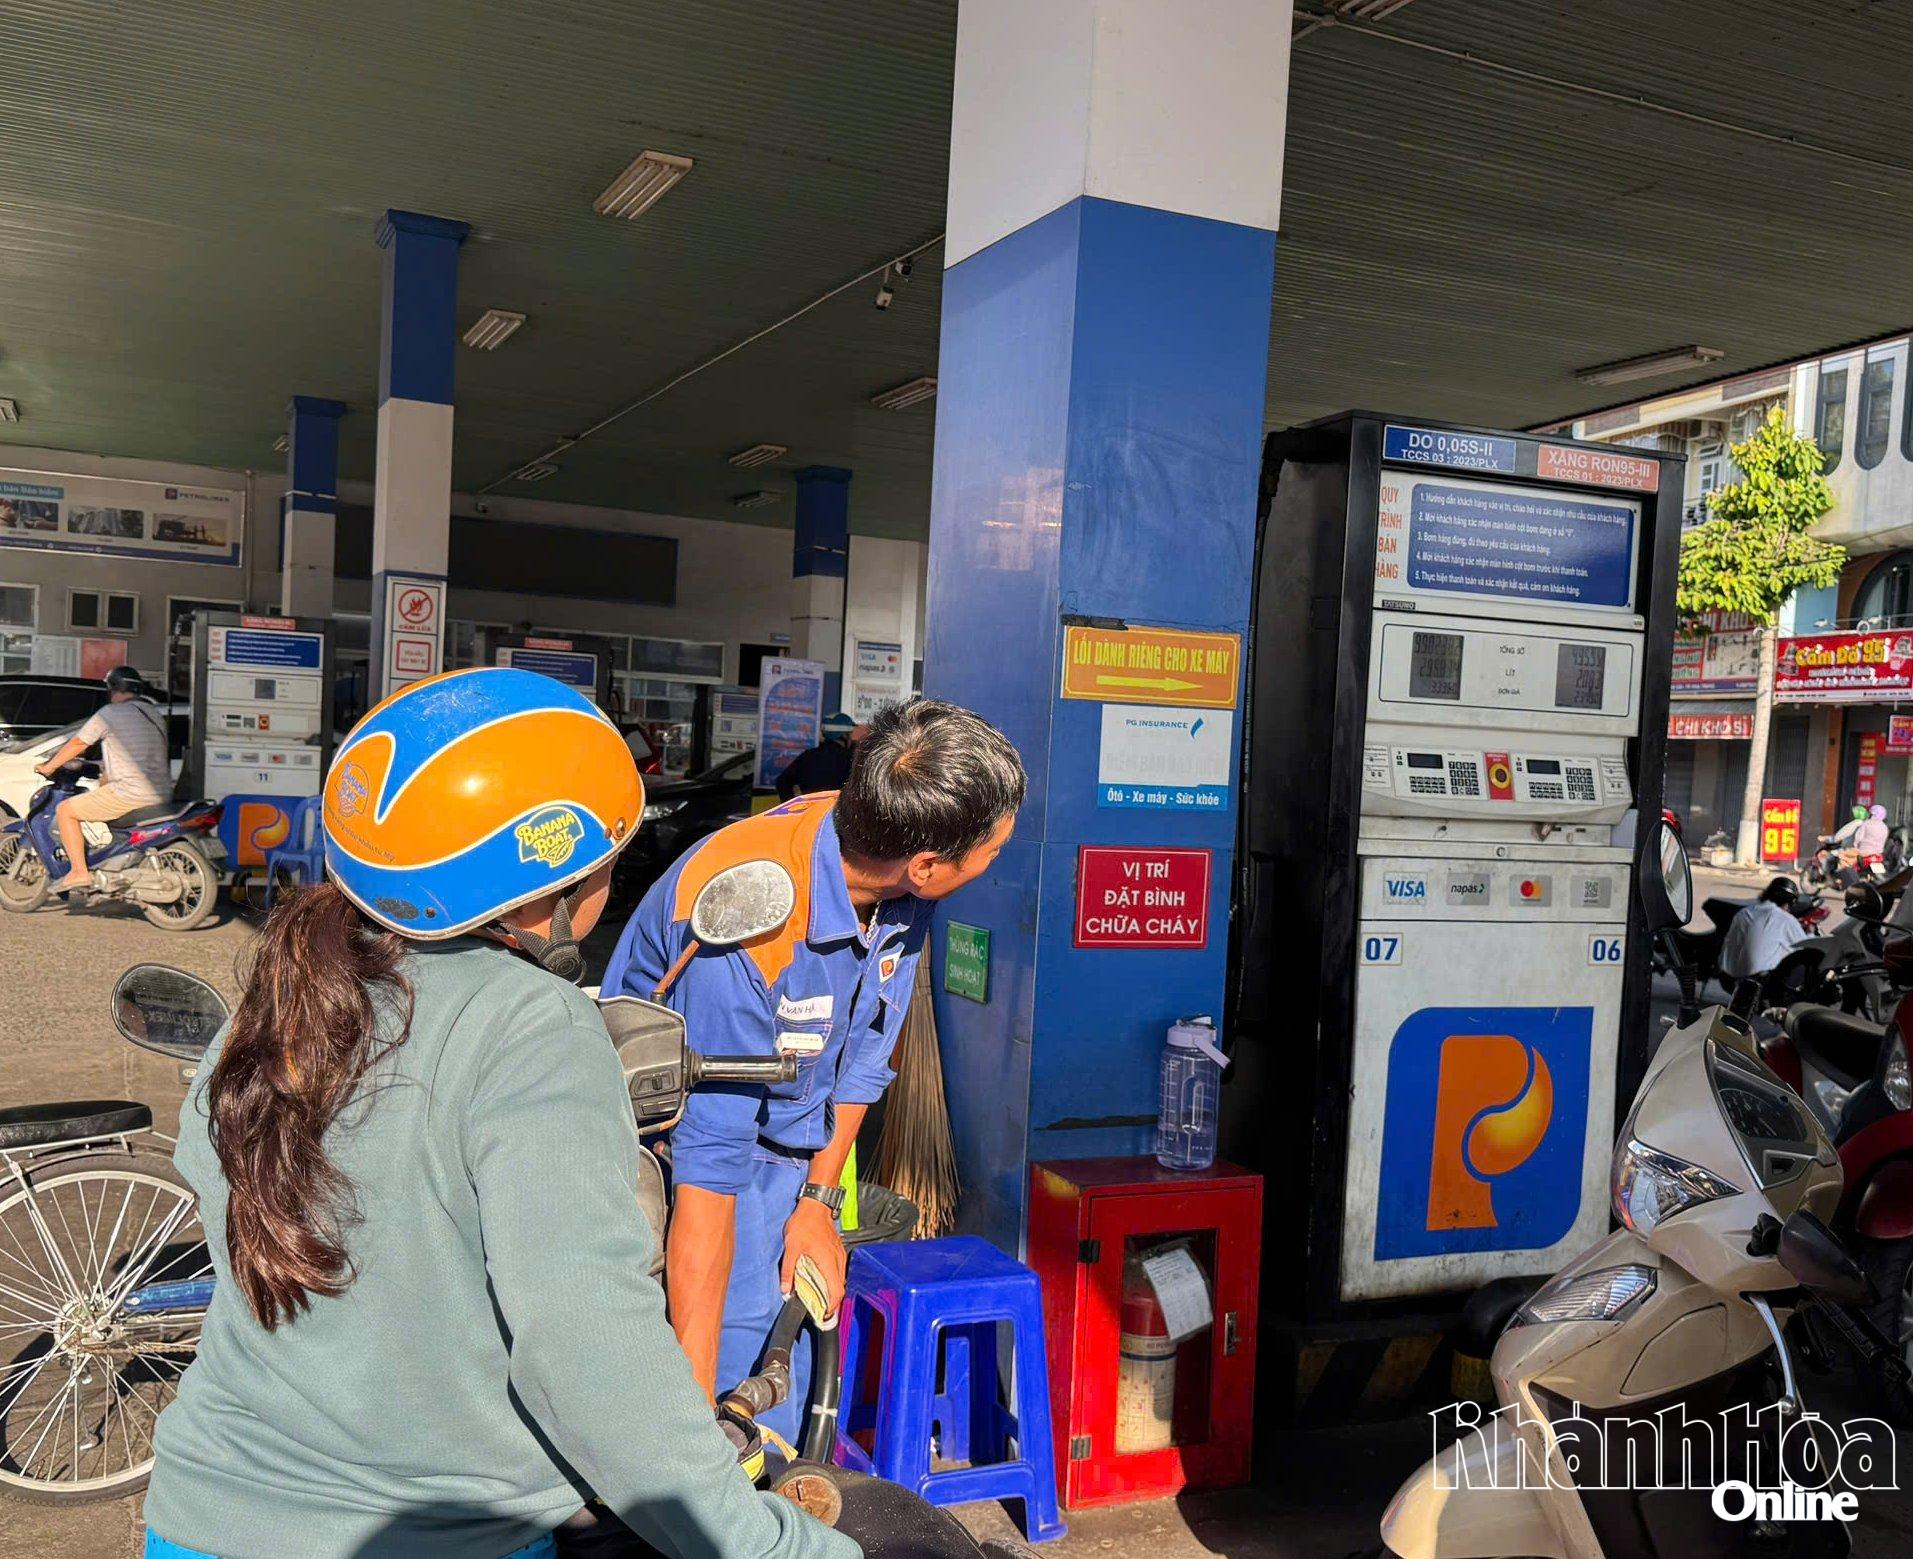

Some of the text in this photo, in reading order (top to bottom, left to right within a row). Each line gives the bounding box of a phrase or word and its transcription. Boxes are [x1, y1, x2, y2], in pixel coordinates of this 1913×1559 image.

[1409, 433, 1493, 456] DO 0,05S-II
[1400, 449, 1430, 461] TCCS
[1432, 454, 1444, 463] 03
[1453, 456, 1499, 469] 2023/PLX
[1591, 456, 1651, 477] RON95-III
[1554, 468, 1581, 480] TCCS
[1582, 472, 1592, 480] 01
[1601, 474, 1643, 488] 2023/PLX
[1381, 487, 1400, 504] QUY
[1458, 495, 1473, 506] khách
[1474, 497, 1488, 510] hàng
[1436, 513, 1453, 525] khách
[1454, 515, 1467, 528] hàng
[1438, 534, 1451, 545] hàng
[1520, 543, 1536, 553] khách
[1434, 552, 1450, 563] khách
[1451, 555, 1464, 566] hàng
[1550, 583, 1566, 594] khách
[1074, 633, 1092, 665] LỐI
[1094, 638, 1125, 667] DÀNH
[1164, 647, 1187, 672] CHO
[1189, 648, 1203, 673] XE
[1206, 647, 1230, 674] MÁY
[1863, 639, 1886, 663] 95
[1139, 720, 1189, 729] INSURANCE
[259, 773, 269, 782] 11
[1132, 790, 1145, 802] Xe
[1147, 791, 1168, 804] máy
[1176, 792, 1194, 804] Sức
[517, 812, 576, 845] BANANA
[1765, 829, 1795, 854] 95
[1123, 859, 1170, 881] VỊ TRÍ
[1104, 886, 1185, 908] ĐẶT BÌNH
[1387, 880, 1426, 897] VISA
[1450, 884, 1478, 895] napas
[1085, 914, 1199, 934] CHỮA CHÁY
[970, 940, 985, 960] RÁC
[1365, 938, 1398, 961] 07
[1592, 939, 1621, 961] 06
